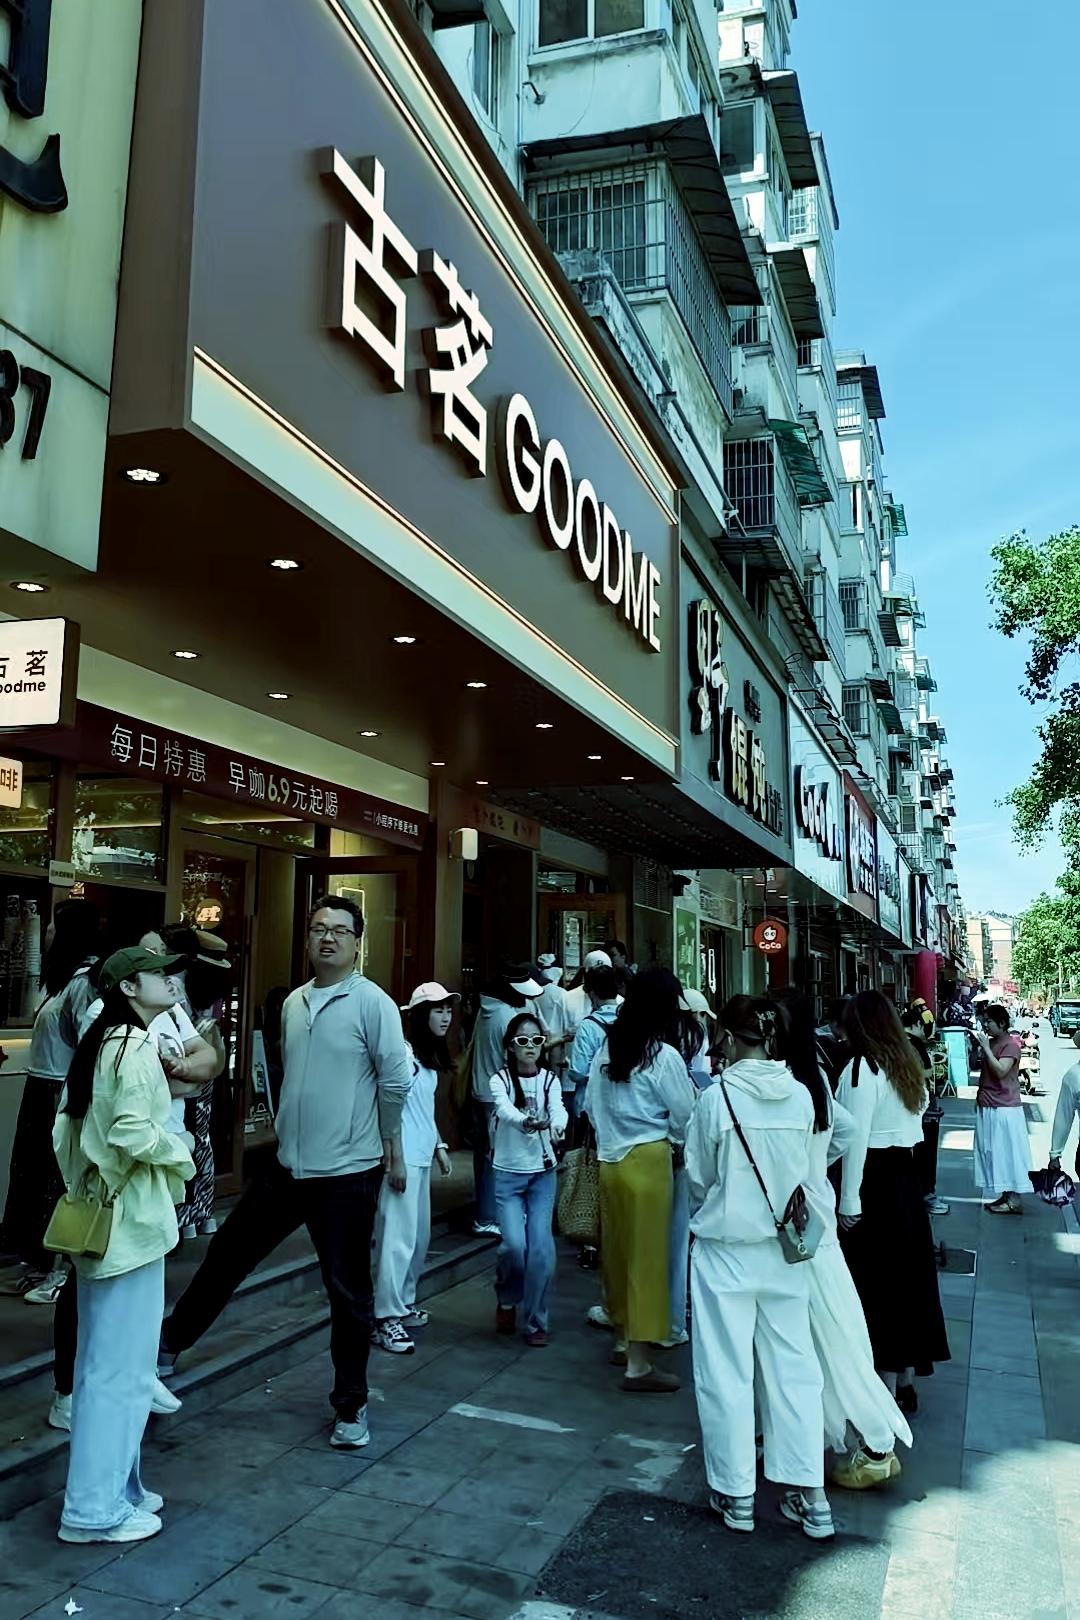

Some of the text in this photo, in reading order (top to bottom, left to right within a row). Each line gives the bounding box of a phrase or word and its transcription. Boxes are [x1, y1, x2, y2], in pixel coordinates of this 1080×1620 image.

[328, 147, 661, 653] 古茗 GOODME
[110, 723, 207, 783] 每日特惠
[758, 941, 782, 950] CoCo
